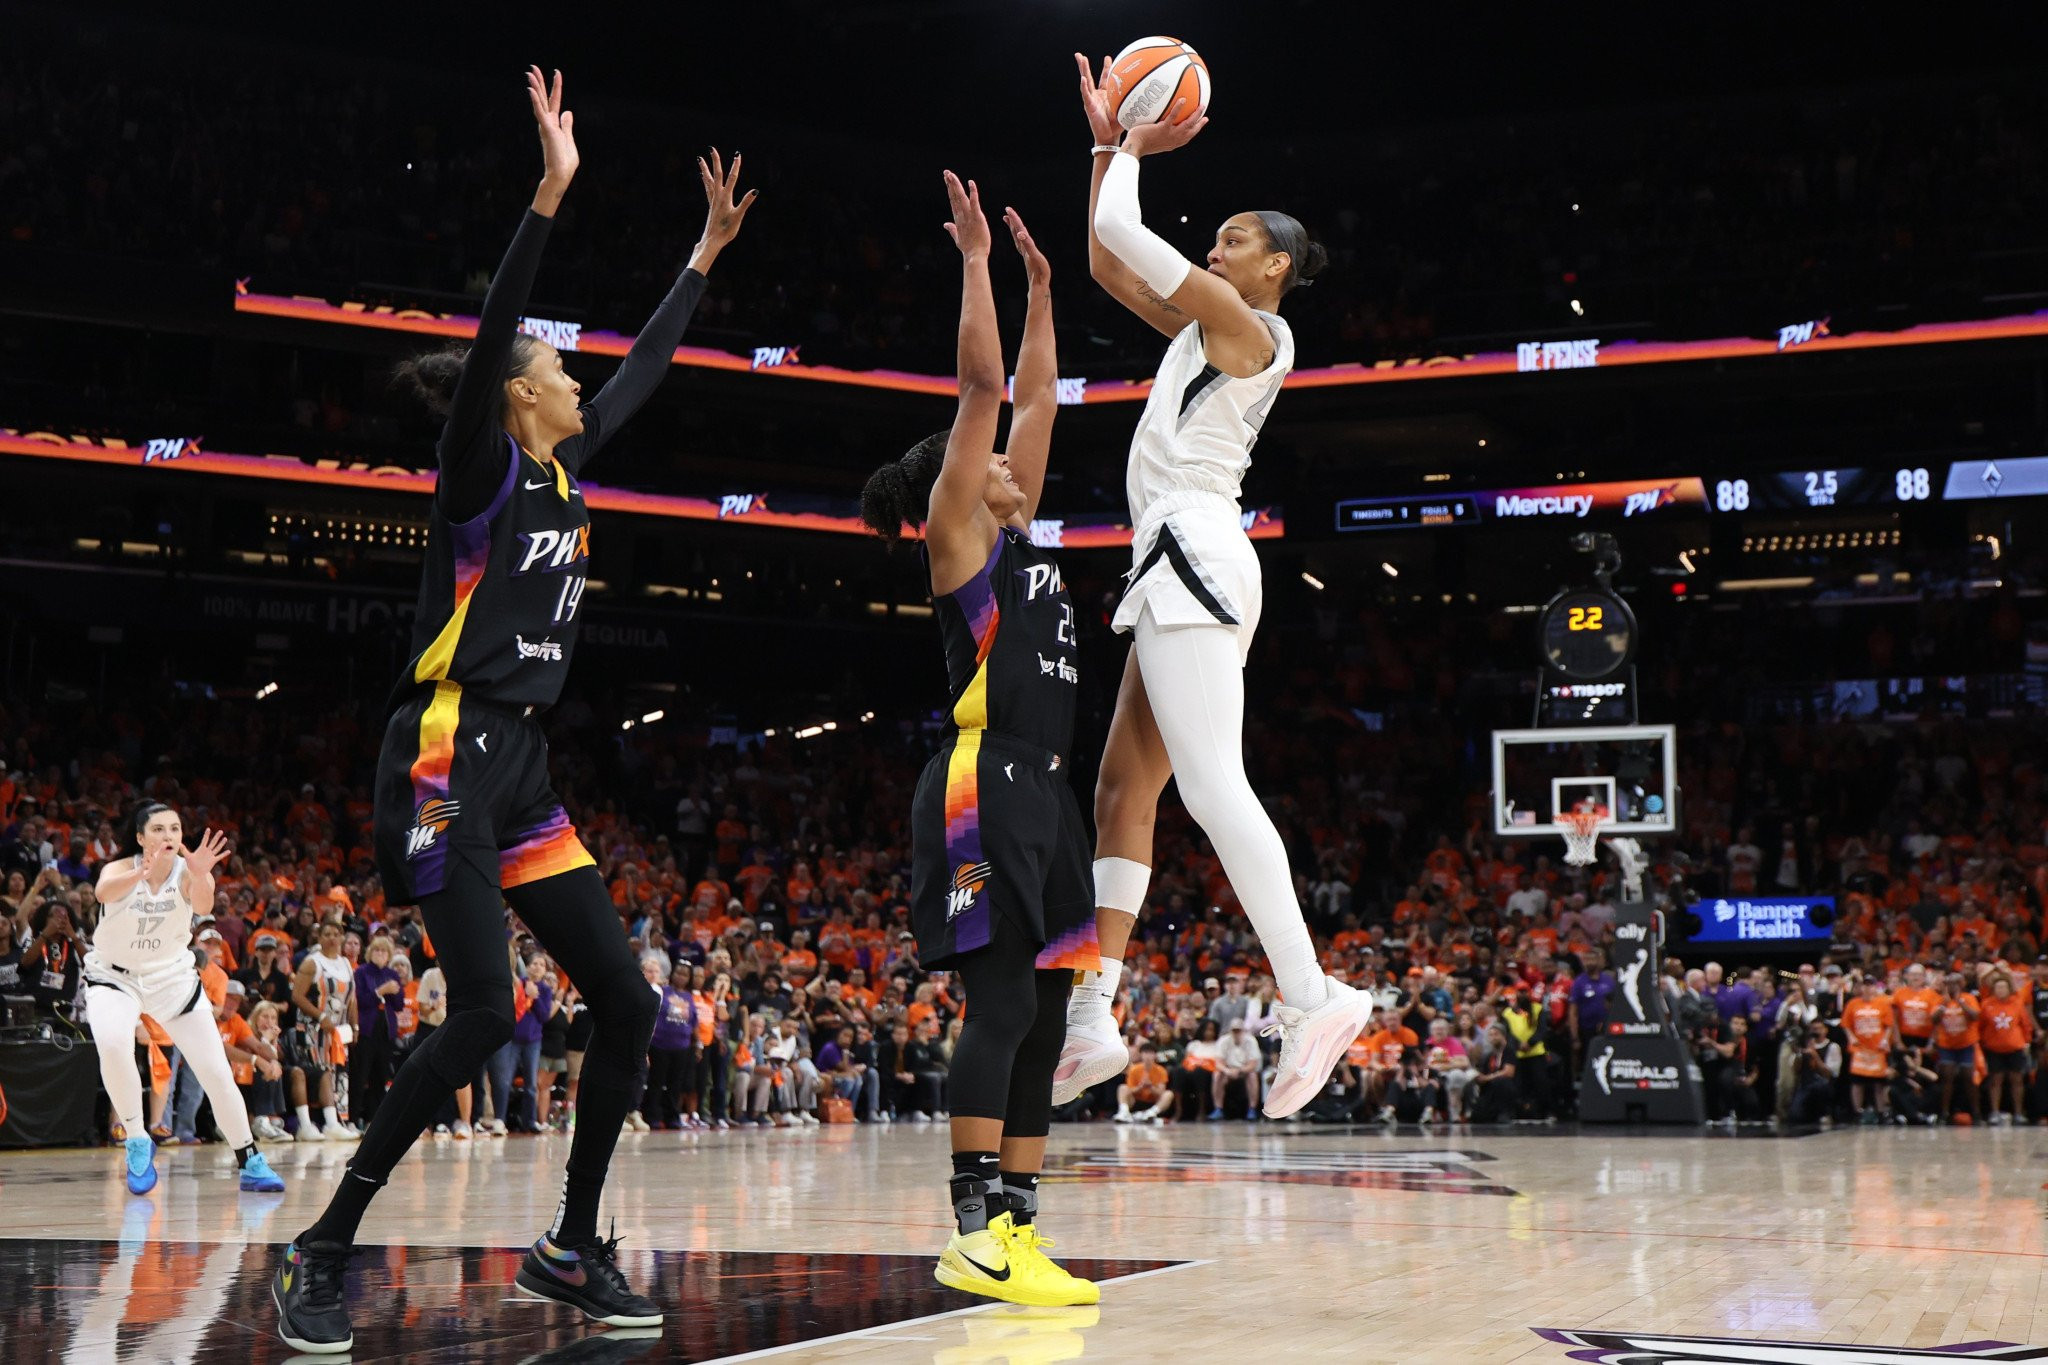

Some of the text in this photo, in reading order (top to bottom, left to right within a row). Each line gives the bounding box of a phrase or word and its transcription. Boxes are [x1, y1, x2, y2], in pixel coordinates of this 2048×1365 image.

[1776, 318, 1830, 351] PHX
[753, 345, 801, 369] PHX
[144, 436, 204, 463] PHX
[1716, 479, 1750, 512] 88
[1804, 470, 1838, 497] 2.5
[1895, 467, 1930, 501] 88
[720, 492, 769, 519] PHX
[1496, 492, 1594, 518] Mercury
[1623, 482, 1679, 518] PHX
[514, 522, 591, 574] PHX
[1020, 563, 1067, 603] PH
[553, 575, 587, 623] 14
[1738, 901, 1808, 921] Banner
[136, 916, 166, 936] 17
[1616, 923, 1647, 943] ally
[1738, 919, 1801, 939] Health
[130, 938, 161, 952] ring
[1610, 1066, 1679, 1079] FINALS
